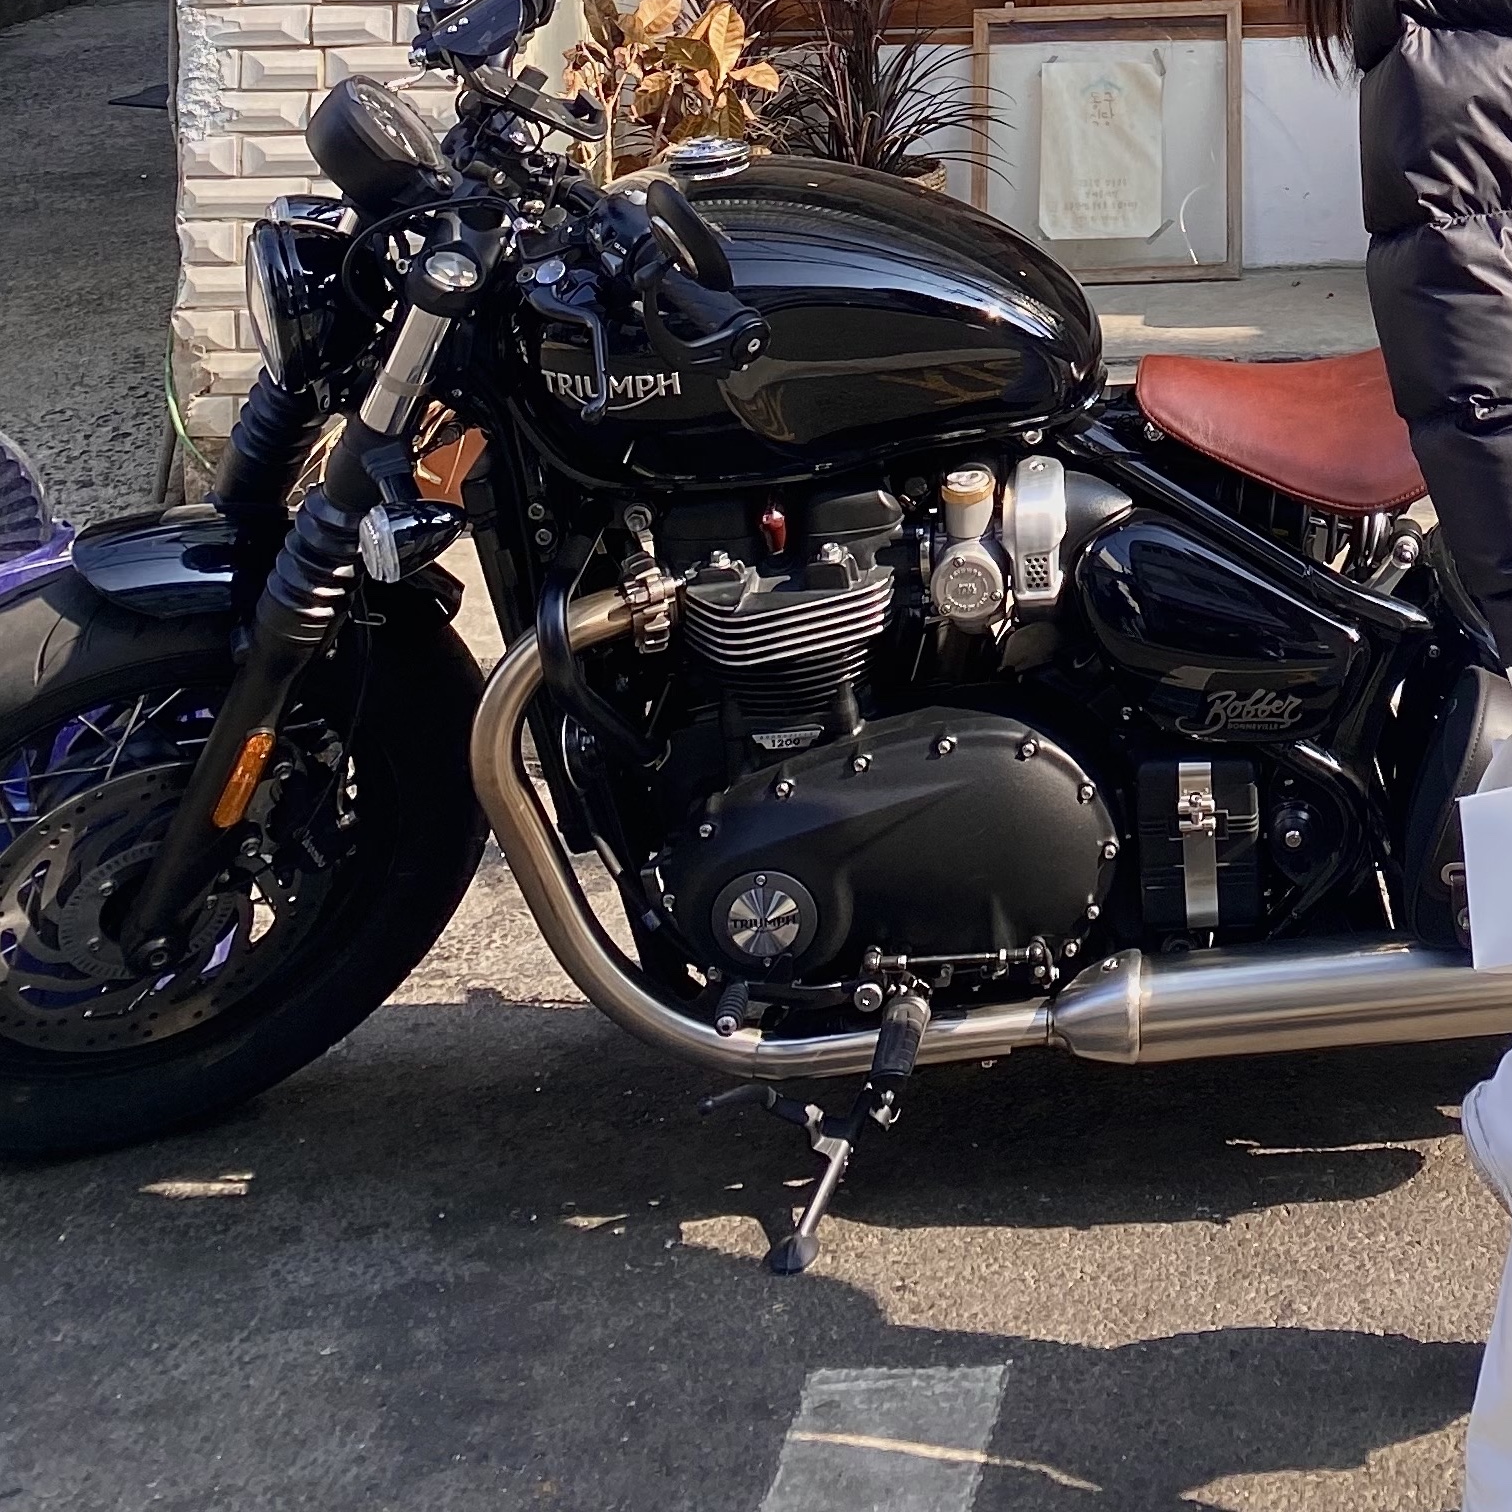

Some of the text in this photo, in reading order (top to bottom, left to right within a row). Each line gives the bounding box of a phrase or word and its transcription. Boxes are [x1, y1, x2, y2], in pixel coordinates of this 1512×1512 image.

[541, 369, 682, 399] TRIUMPH
[1175, 688, 1303, 735] Bobber
[771, 737, 801, 748] 1200
[731, 913, 797, 930] TRIUMPH
